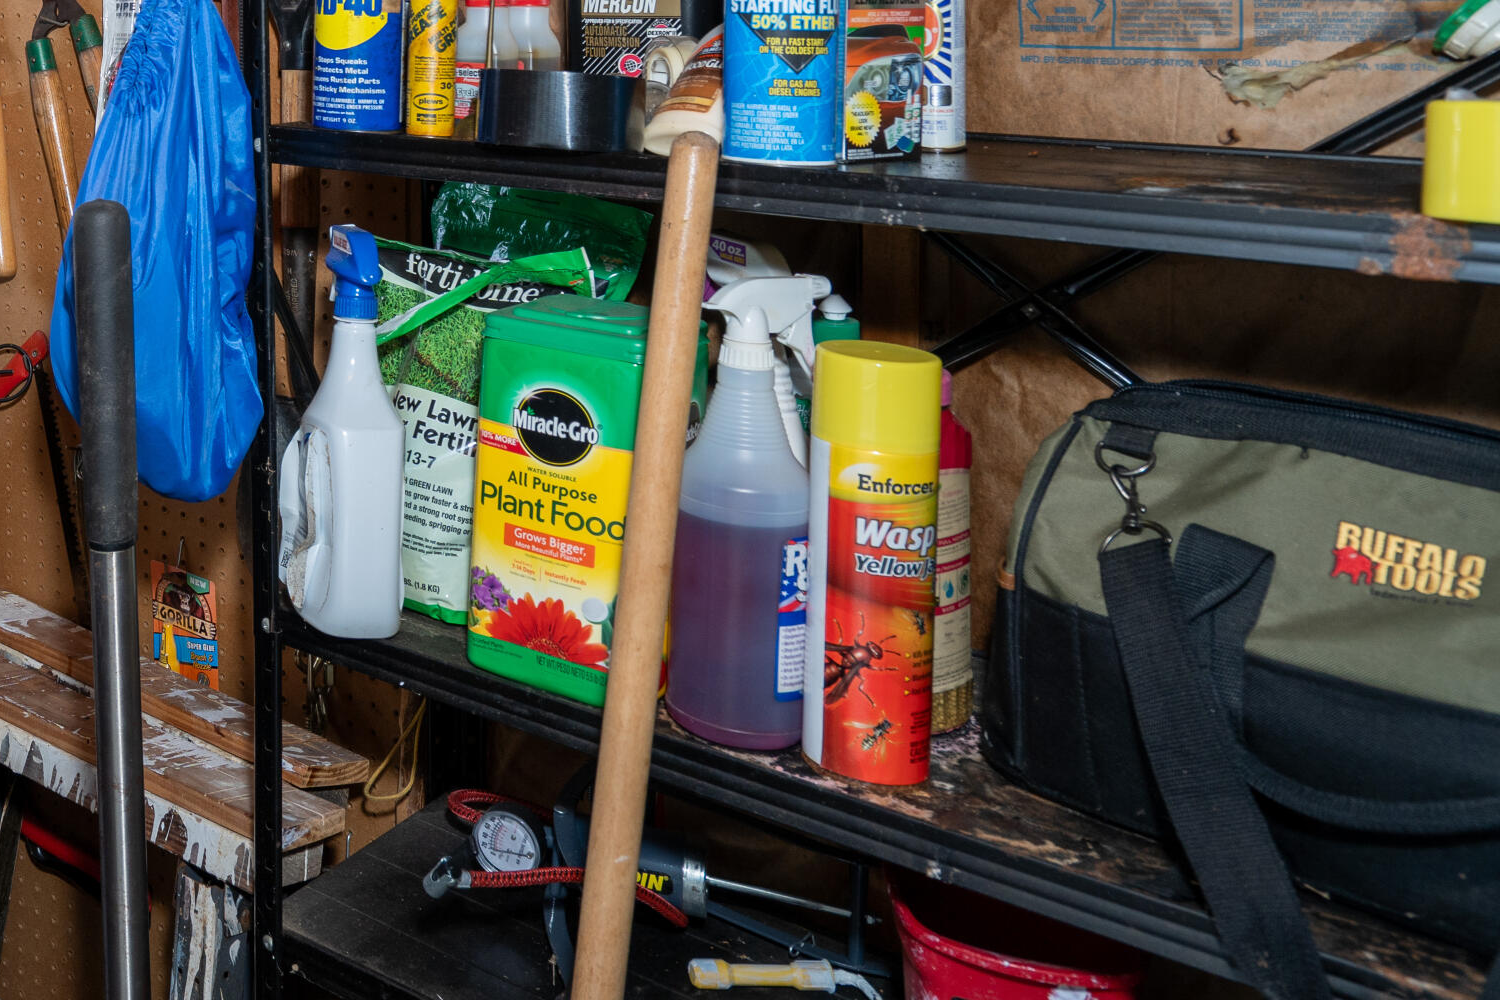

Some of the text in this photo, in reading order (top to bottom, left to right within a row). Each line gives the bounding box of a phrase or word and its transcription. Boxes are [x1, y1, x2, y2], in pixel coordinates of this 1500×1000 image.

[751, 15, 786, 30] 50%
[790, 15, 835, 30] ETHER
[585, 26, 627, 36] AUTOMATIC
[585, 37, 640, 48] TRANSMISSION
[766, 37, 824, 47] FOR A FAST START
[585, 48, 607, 58] FLUID
[759, 46, 770, 54] ON
[771, 46, 784, 54] THE
[785, 46, 815, 55] COLDEST
[335, 57, 368, 65] Squeaks
[1043, 56, 1055, 64] BY
[1057, 56, 1120, 66] CERTAINTEED
[317, 65, 368, 75] Protects Metal
[330, 76, 380, 85] Rusted Parts
[774, 79, 789, 88] FOR
[790, 79, 804, 88] GAS
[319, 85, 386, 95] Sticky Mechanisms
[768, 87, 821, 97] DIESEL ENGINES
[712, 239, 745, 257] 40 oz.
[513, 407, 599, 445] Miracle-Gro
[481, 430, 494, 440] 10%
[527, 466, 577, 482] WATER SOLUBLE
[409, 477, 454, 496] GREEN LAWN
[508, 470, 598, 504] All Purpose
[857, 474, 934, 496] Enforcer
[413, 491, 431, 502] grow
[431, 496, 451, 508] faster
[481, 480, 545, 523] Plant
[418, 506, 440, 518] strong
[441, 512, 457, 520] root
[429, 519, 462, 535] sprigging
[514, 527, 587, 557] Grows Bigger,
[855, 515, 937, 557] Wasp
[515, 540, 559, 557] More Beautiful
[1336, 521, 1488, 579] BUFFALO
[853, 553, 924, 578] Yellow
[189, 576, 207, 590] NEW
[414, 580, 440, 594] (1.8 KG)
[1374, 560, 1483, 601] TOOLS
[159, 606, 209, 637] GORILLA
